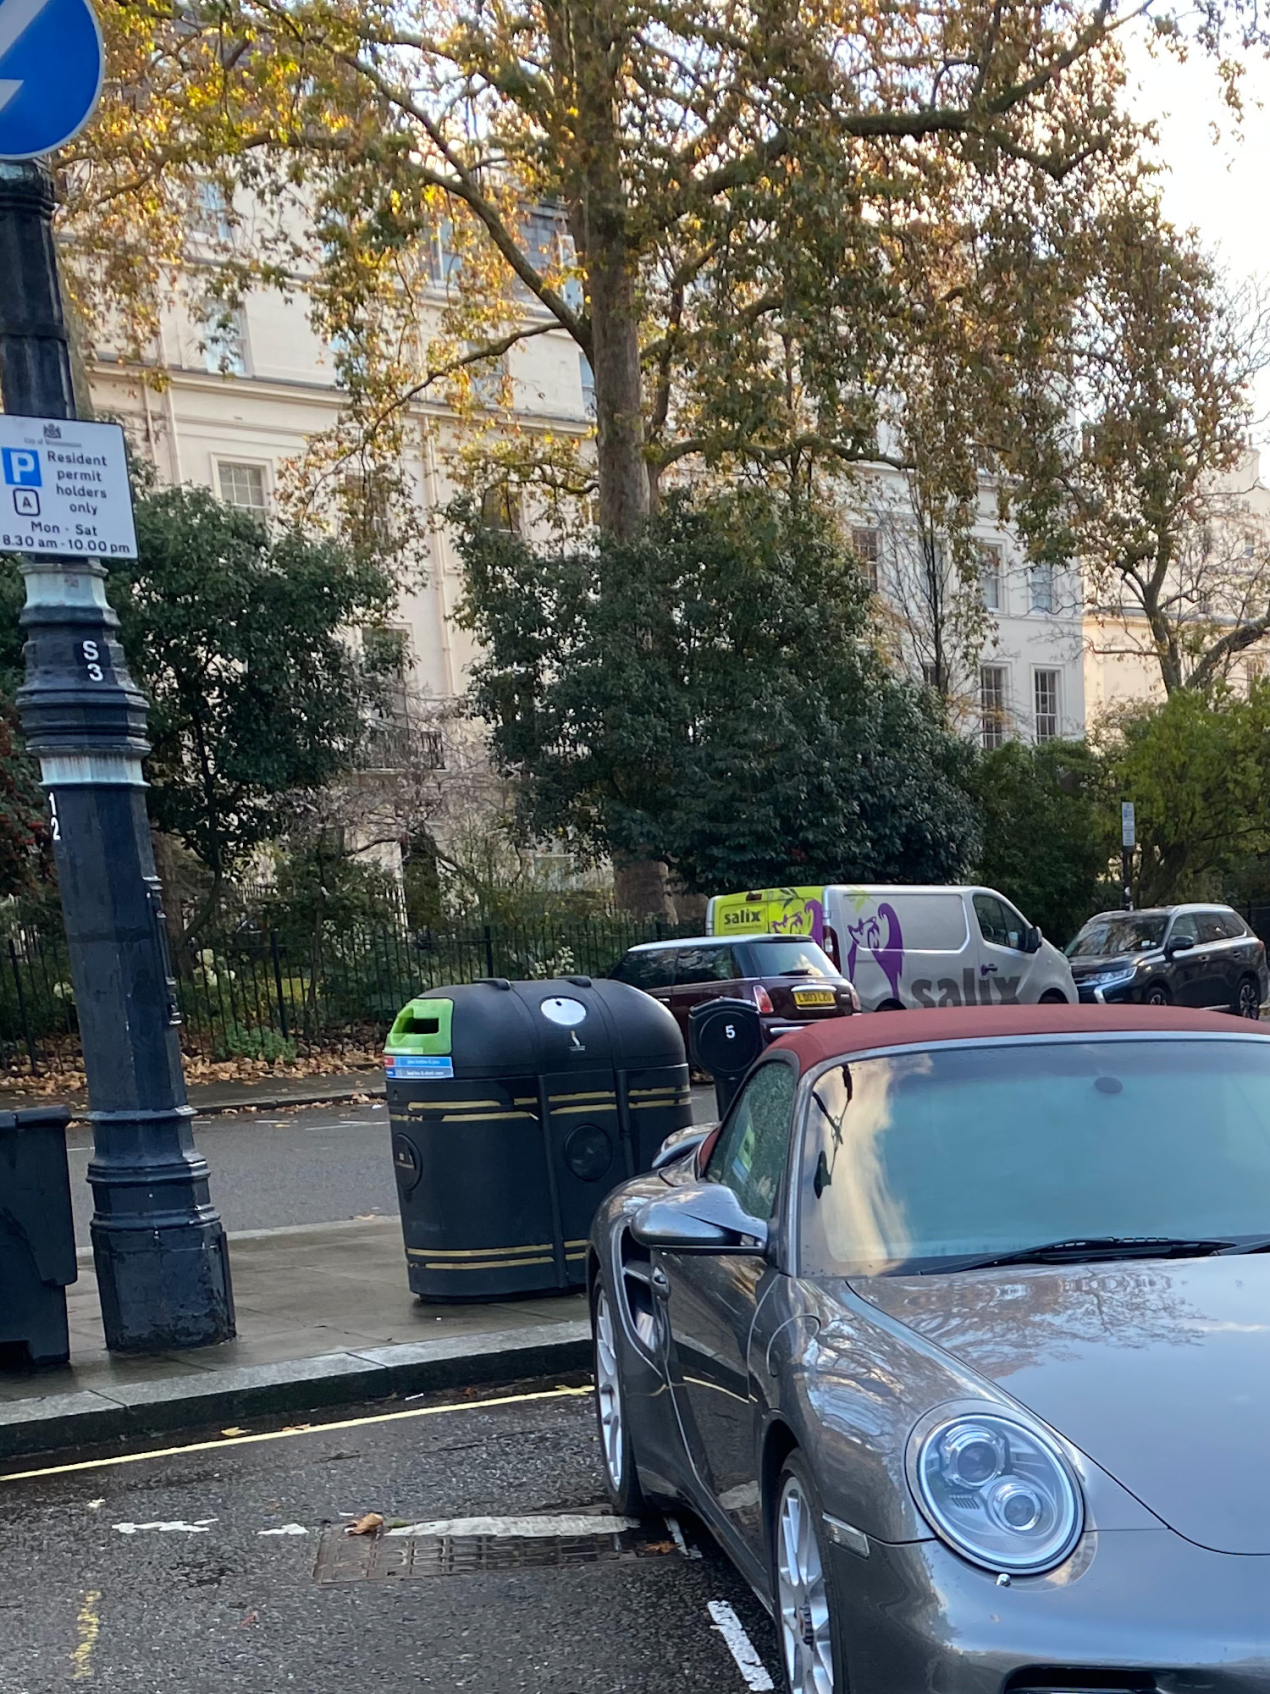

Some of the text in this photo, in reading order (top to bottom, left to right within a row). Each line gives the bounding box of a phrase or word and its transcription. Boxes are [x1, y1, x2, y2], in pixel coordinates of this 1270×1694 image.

[47, 450, 107, 466] Resident
[10, 450, 35, 483] P
[57, 469, 102, 482] permit
[56, 483, 107, 499] holders
[22, 496, 32, 508] A
[69, 502, 98, 516] only
[30, 520, 60, 534] Mon
[75, 523, 98, 537] Sat
[2, 534, 34, 547] 8.30
[38, 539, 58, 549] am
[69, 538, 107, 552] 10.00
[110, 543, 130, 554] pm
[724, 909, 761, 926] salix
[911, 967, 1022, 1009] salix
[725, 1024, 736, 1039] 5
